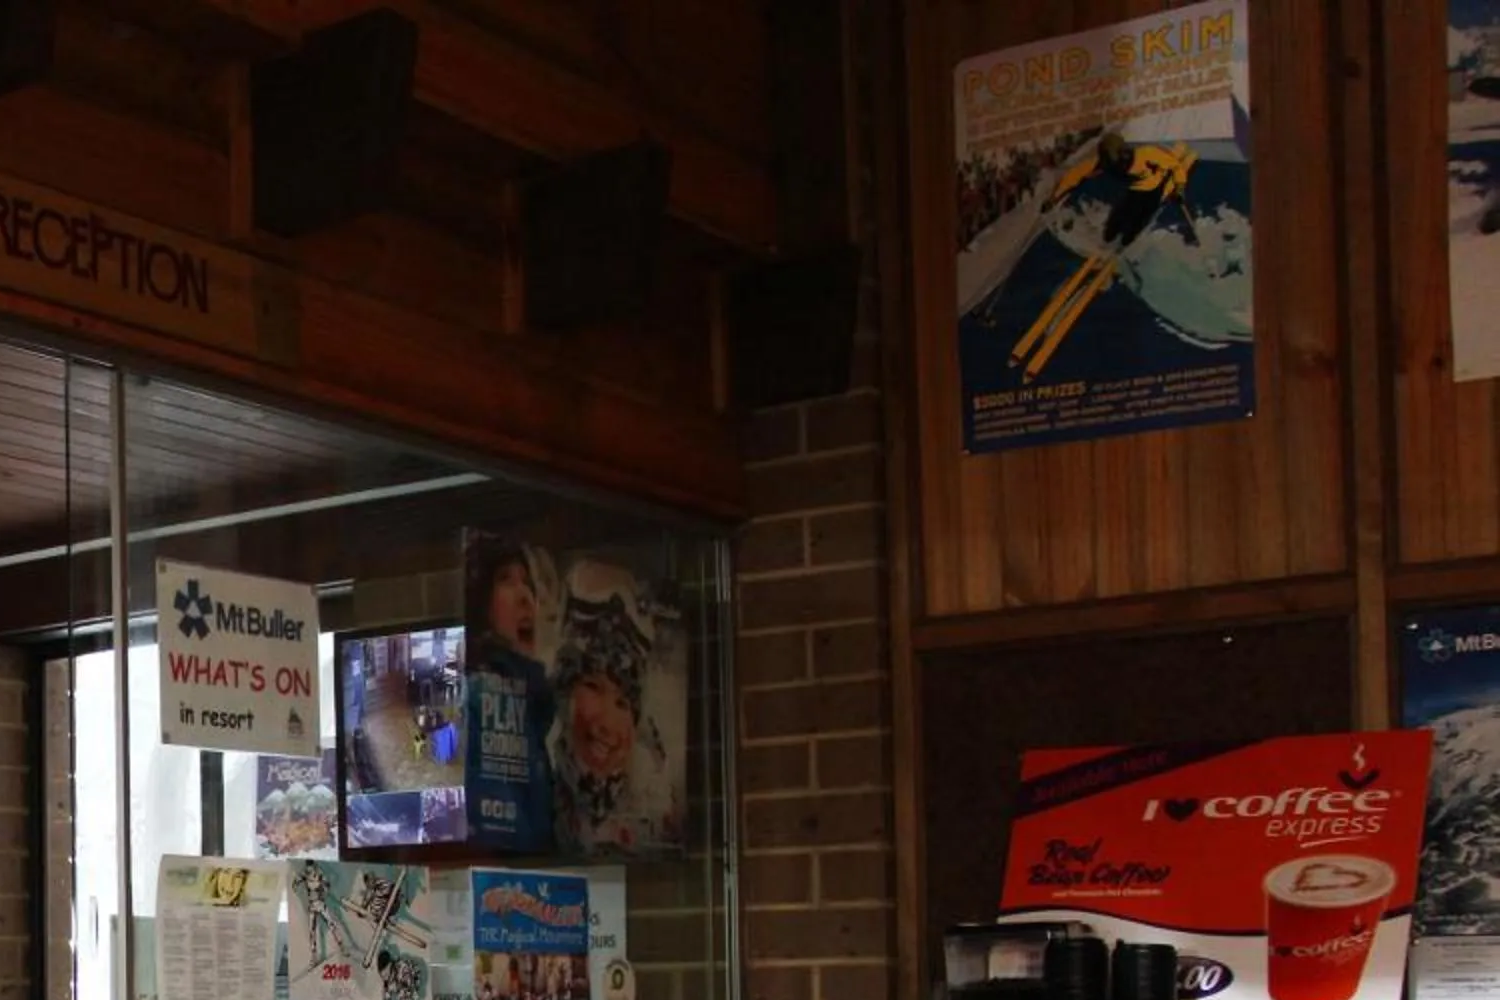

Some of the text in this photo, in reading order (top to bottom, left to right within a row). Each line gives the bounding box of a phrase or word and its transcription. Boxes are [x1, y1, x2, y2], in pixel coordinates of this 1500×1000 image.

[964, 47, 1092, 99] POND
[1110, 9, 1233, 70] SKIM
[168, 652, 311, 697] WHAT'S ON
[179, 701, 255, 731] in resort
[1203, 787, 1391, 819] coffee
[1265, 815, 1383, 841] express
